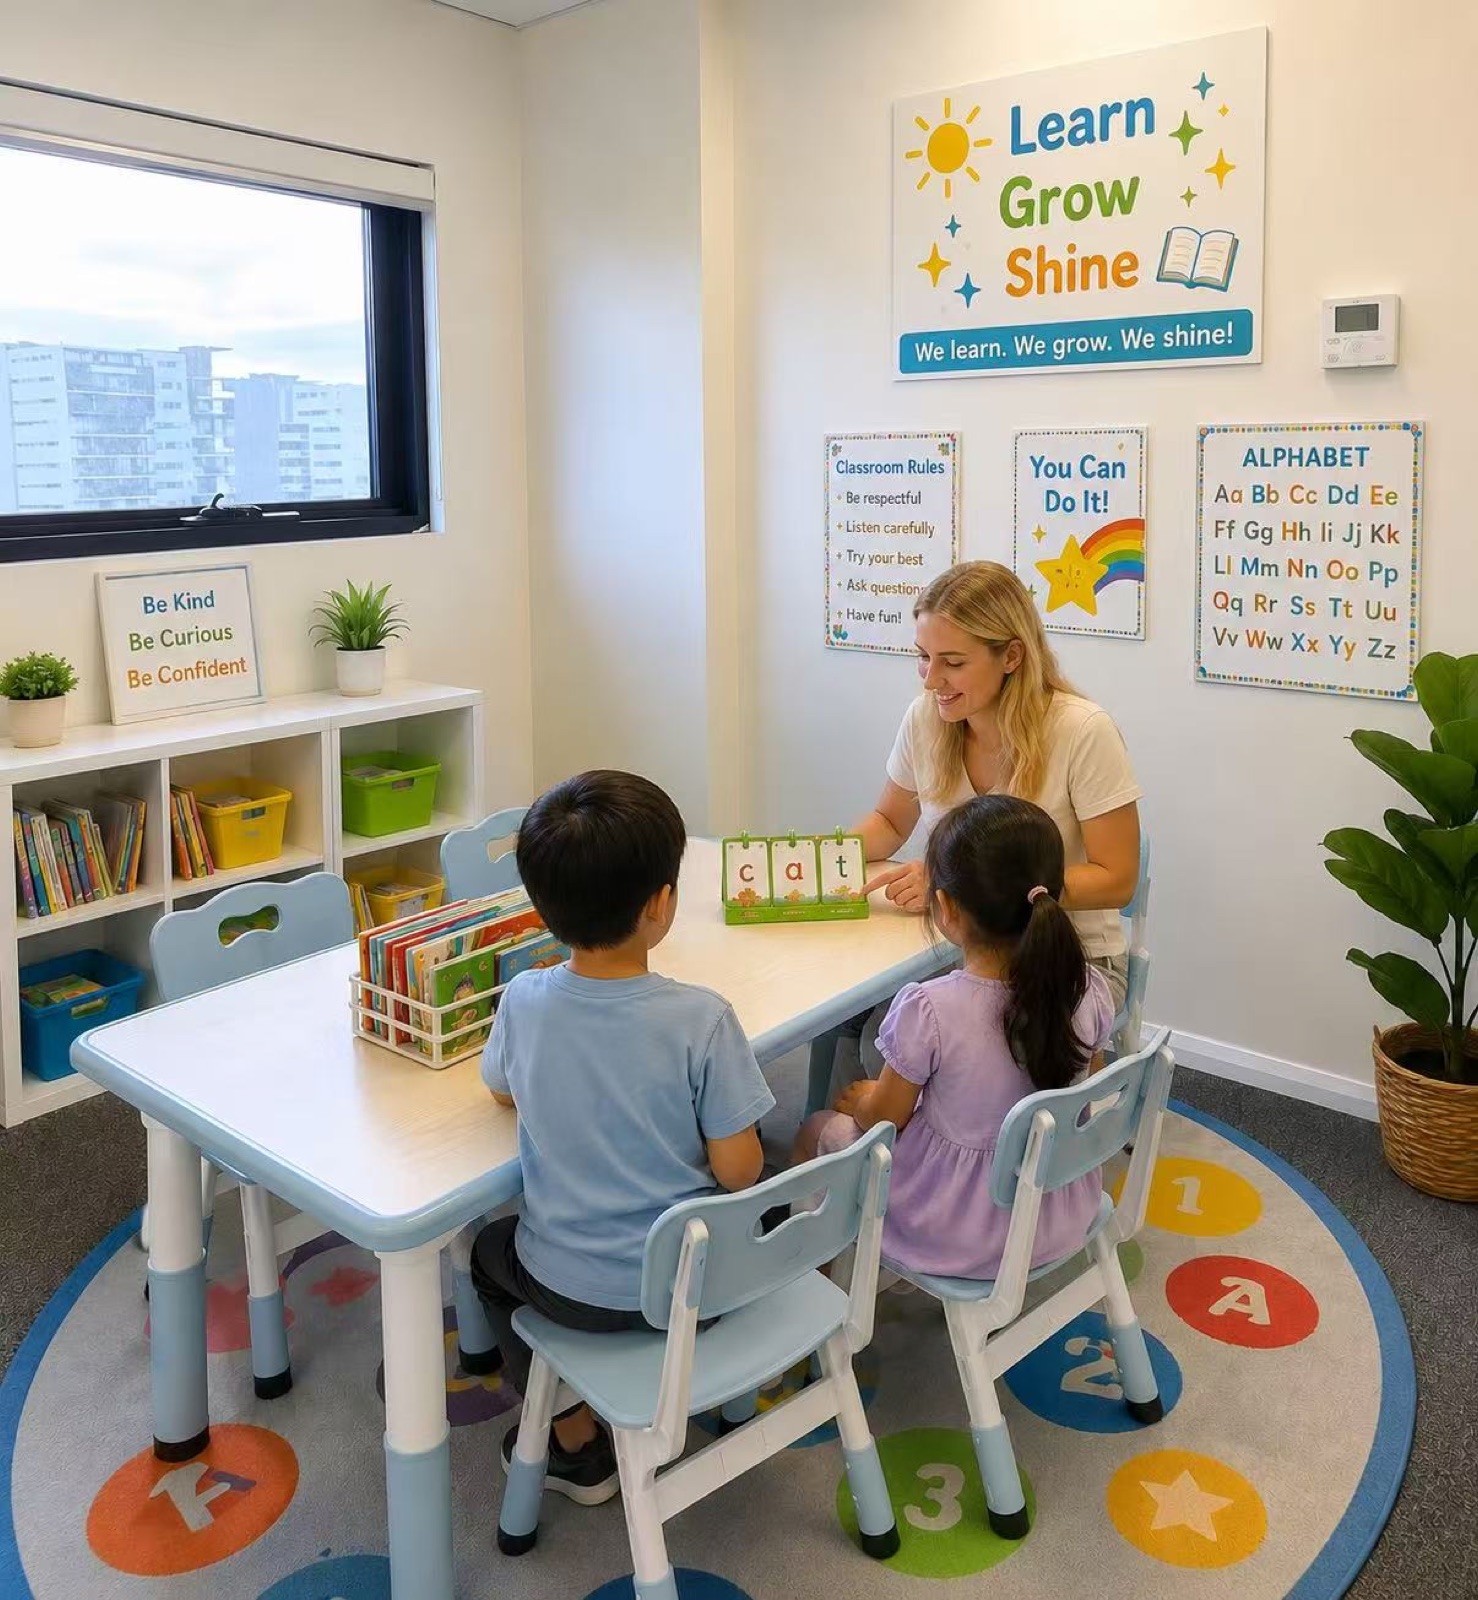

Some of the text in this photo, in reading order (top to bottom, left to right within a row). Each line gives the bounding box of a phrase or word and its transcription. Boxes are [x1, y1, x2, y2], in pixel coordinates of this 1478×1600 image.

[1010, 96, 1155, 156] Learn
[999, 175, 1140, 229] Grow
[1005, 243, 1139, 298] Shine
[915, 321, 1234, 362] We learn. We grow. We shine!
[835, 459, 945, 475] Classroom Rules
[1030, 454, 1126, 479] You Can
[1242, 447, 1370, 468] ALPHABET
[846, 490, 922, 506] Be respectful
[1045, 489, 1109, 514] Do It!
[1214, 484, 1398, 505] Aa Bb Cc Dd Ee
[846, 520, 935, 539] Listen carefully
[1214, 520, 1236, 539] Ff
[1244, 521, 1273, 546] Gg
[1281, 521, 1311, 541] Hh
[1342, 522, 1362, 548] Jj
[1371, 523, 1400, 544] Kk
[846, 550, 924, 568] Try your best
[1214, 555, 1399, 588] Ll Mm Nn Oo Pp
[846, 579, 924, 597] Ask question
[143, 590, 216, 614] Be Kind
[1213, 591, 1396, 621] Qq Rr Ss Tt Uu
[846, 608, 902, 624] Have fun!
[129, 625, 233, 651] Be Curious
[1213, 626, 1396, 661] Vv Ww Xx Yy Zz
[128, 656, 248, 689] Be Confident
[1171, 1176, 1205, 1216] 1
[1208, 1276, 1271, 1326] A
[903, 1462, 966, 1531] 3
